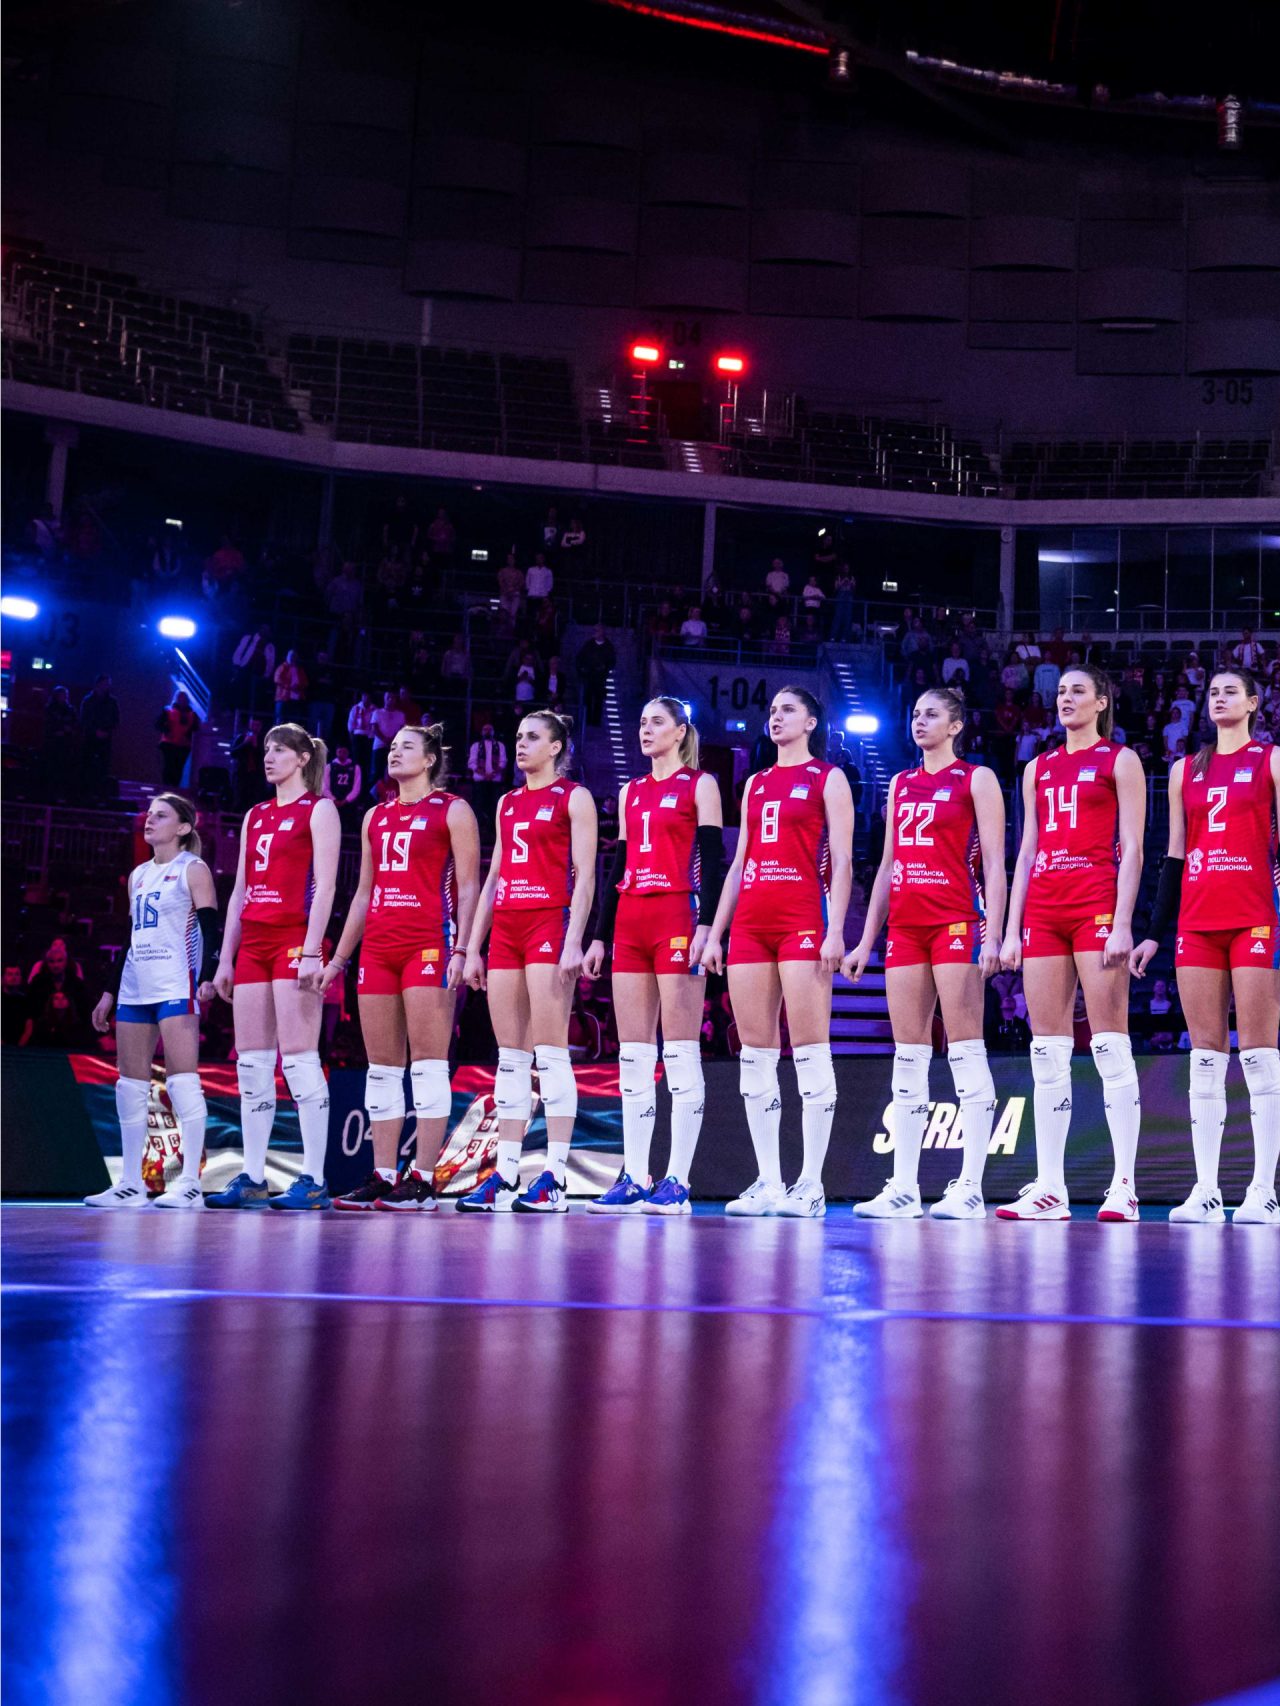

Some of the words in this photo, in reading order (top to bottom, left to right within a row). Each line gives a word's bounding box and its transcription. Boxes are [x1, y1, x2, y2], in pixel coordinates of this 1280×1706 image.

[1202, 379, 1253, 406] 3-05
[708, 675, 768, 712] 1-04
[337, 774, 349, 785] 22
[761, 801, 781, 843] 8
[897, 802, 936, 846] 22
[1044, 785, 1079, 832] 14
[1207, 786, 1228, 833] 2
[511, 822, 530, 863] 5
[640, 811, 652, 852] 1
[255, 833, 275, 872] 9
[379, 832, 412, 872] 19
[134, 891, 161, 931] 16
